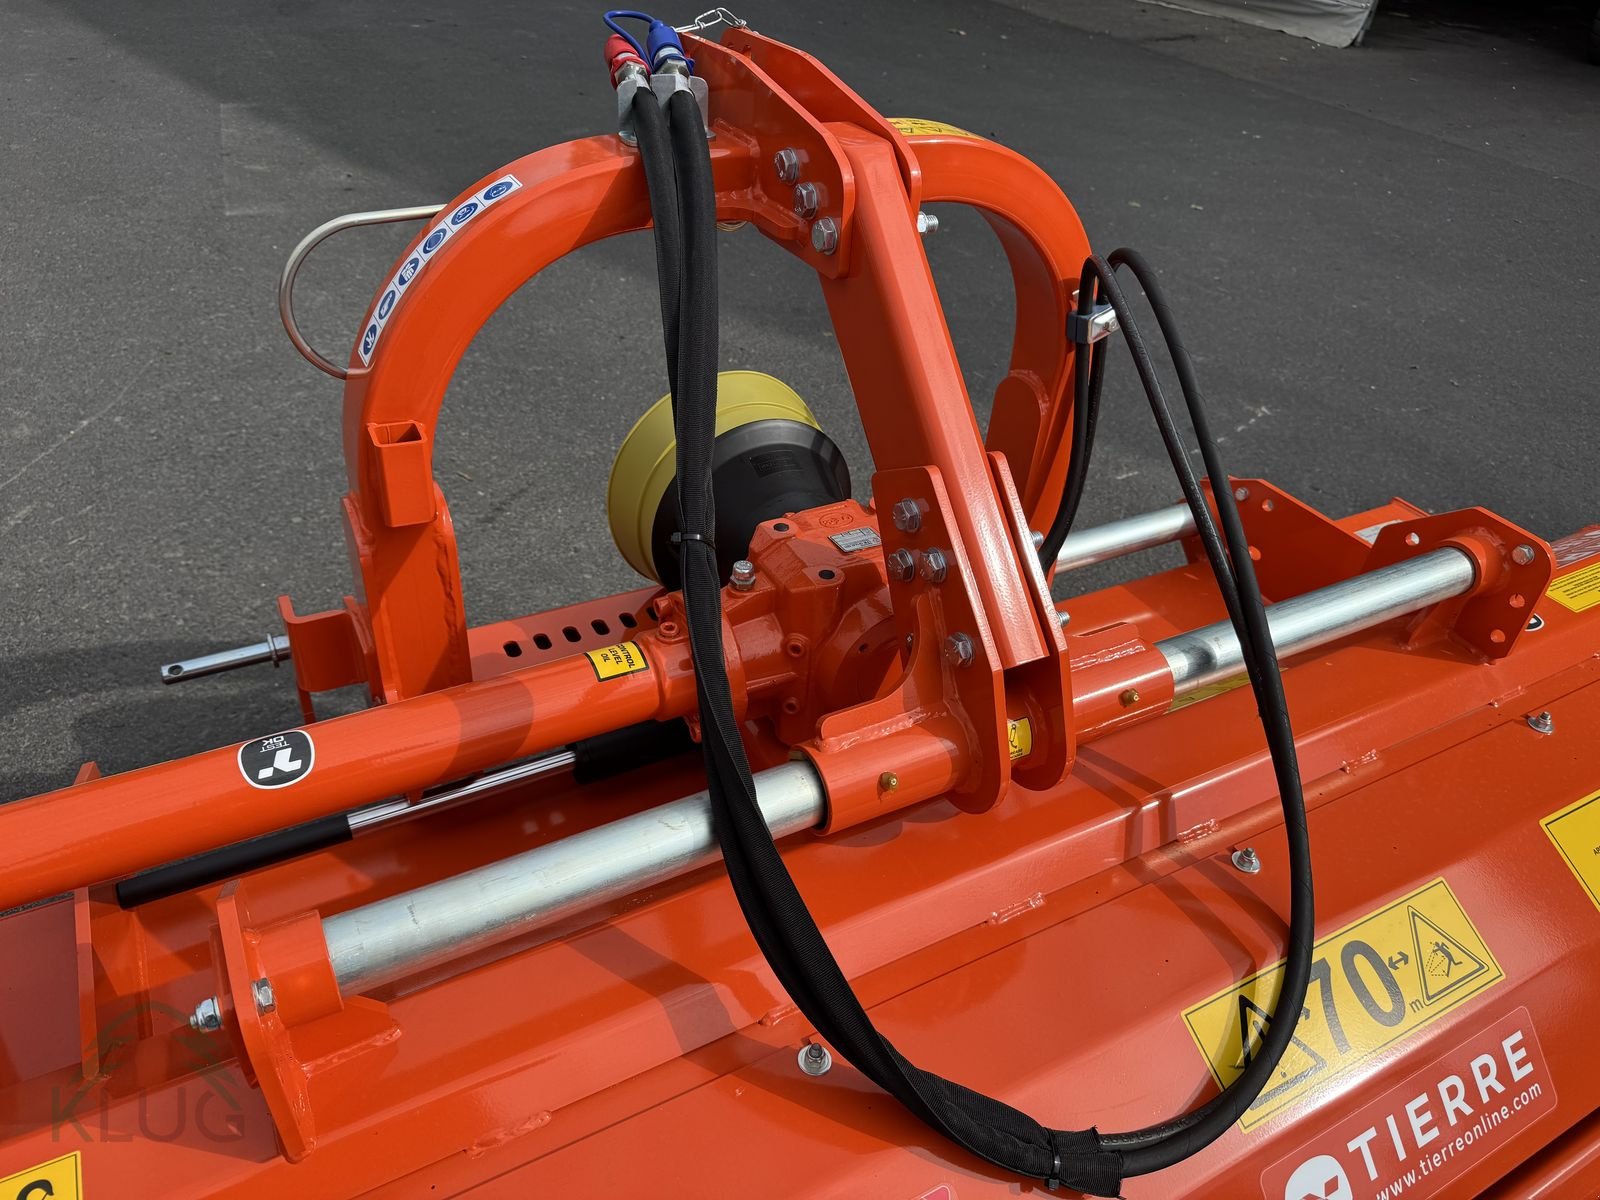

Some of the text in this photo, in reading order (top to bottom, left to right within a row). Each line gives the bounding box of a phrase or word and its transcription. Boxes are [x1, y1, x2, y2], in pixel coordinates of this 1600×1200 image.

[601, 653, 611, 663] OIL
[609, 648, 623, 665] LEVEL
[615, 643, 636, 668] CONTROL
[260, 741, 290, 753] TEST
[262, 735, 285, 747] OK
[1309, 939, 1424, 1056] 70 m
[1346, 1030, 1534, 1182] TIERRE
[1376, 1082, 1543, 1200] www.tierreonline.com
